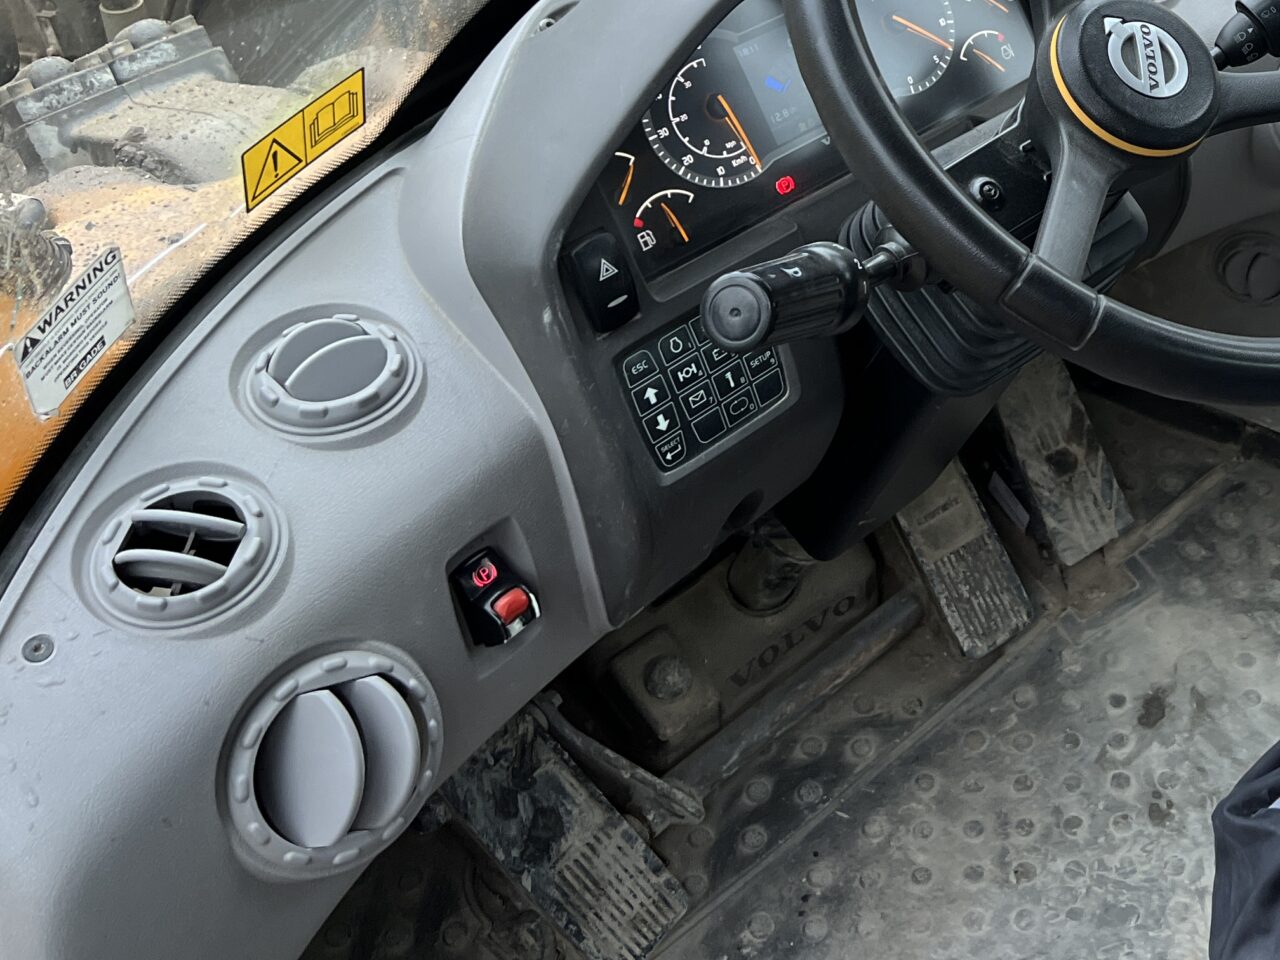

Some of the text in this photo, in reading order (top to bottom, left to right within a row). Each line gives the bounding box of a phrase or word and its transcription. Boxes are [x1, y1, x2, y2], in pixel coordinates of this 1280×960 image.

[1140, 23, 1160, 93] VOLVO
[657, 127, 669, 139] 30
[681, 154, 694, 166] 20
[716, 166, 725, 176] 10
[37, 249, 117, 335] WARNING
[25, 326, 70, 380] BACKALARM
[70, 303, 92, 329] MUST
[64, 341, 105, 388] BRGADE
[631, 359, 649, 375] ESC
[750, 350, 771, 369] SETUP
[660, 436, 681, 454] SELECT
[726, 595, 856, 688] VOLVO
